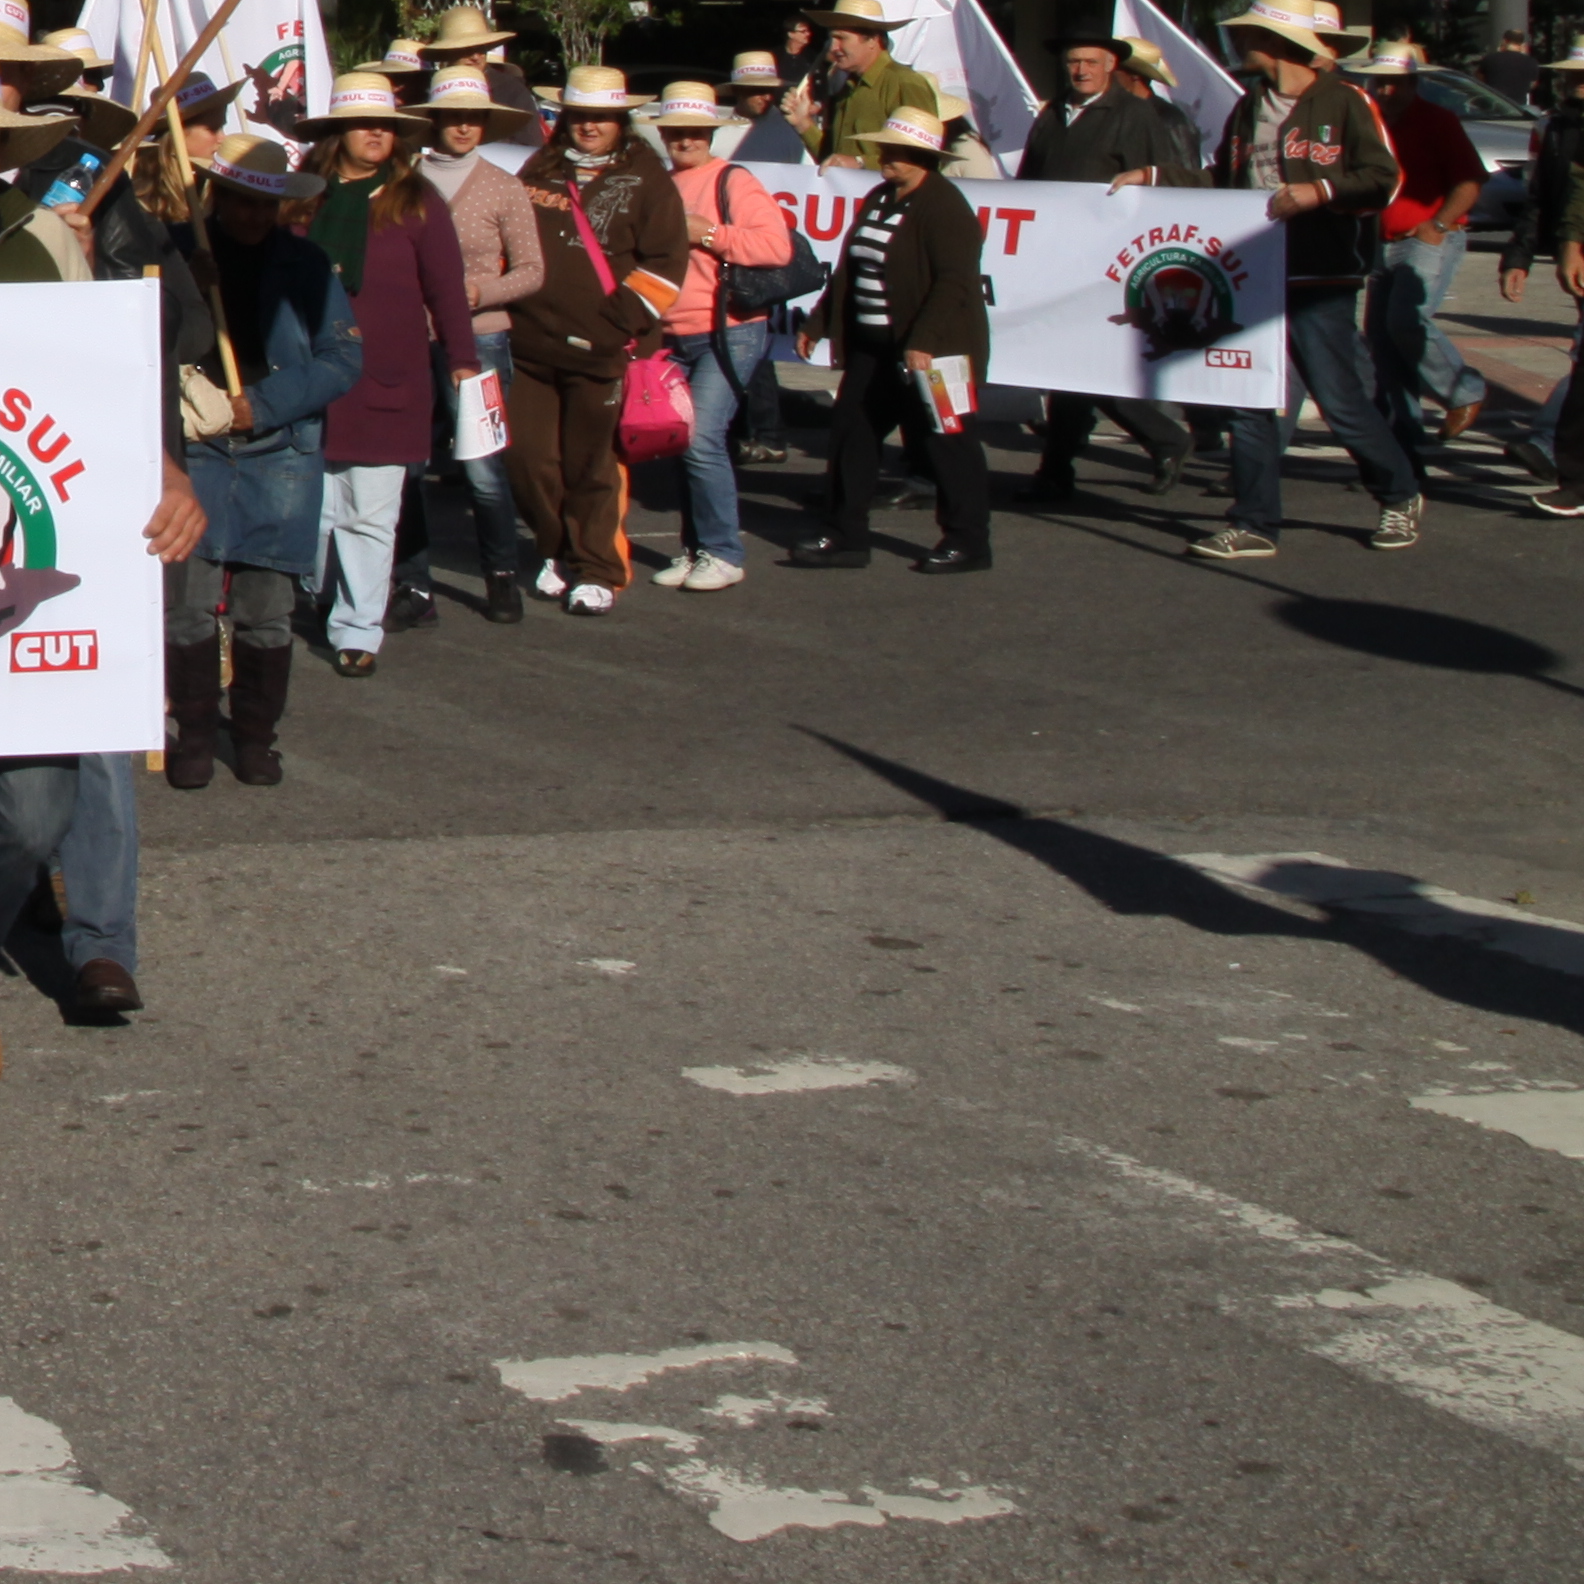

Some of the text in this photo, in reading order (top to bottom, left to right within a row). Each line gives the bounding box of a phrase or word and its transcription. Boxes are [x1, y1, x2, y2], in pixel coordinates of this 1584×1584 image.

[5, 4, 24, 22] CUT
[1104, 223, 1250, 292] FETRAF-SUL
[1130, 251, 1188, 290] AGRICULTURA
[1206, 349, 1250, 367] CUT
[14, 633, 95, 670] CUT
